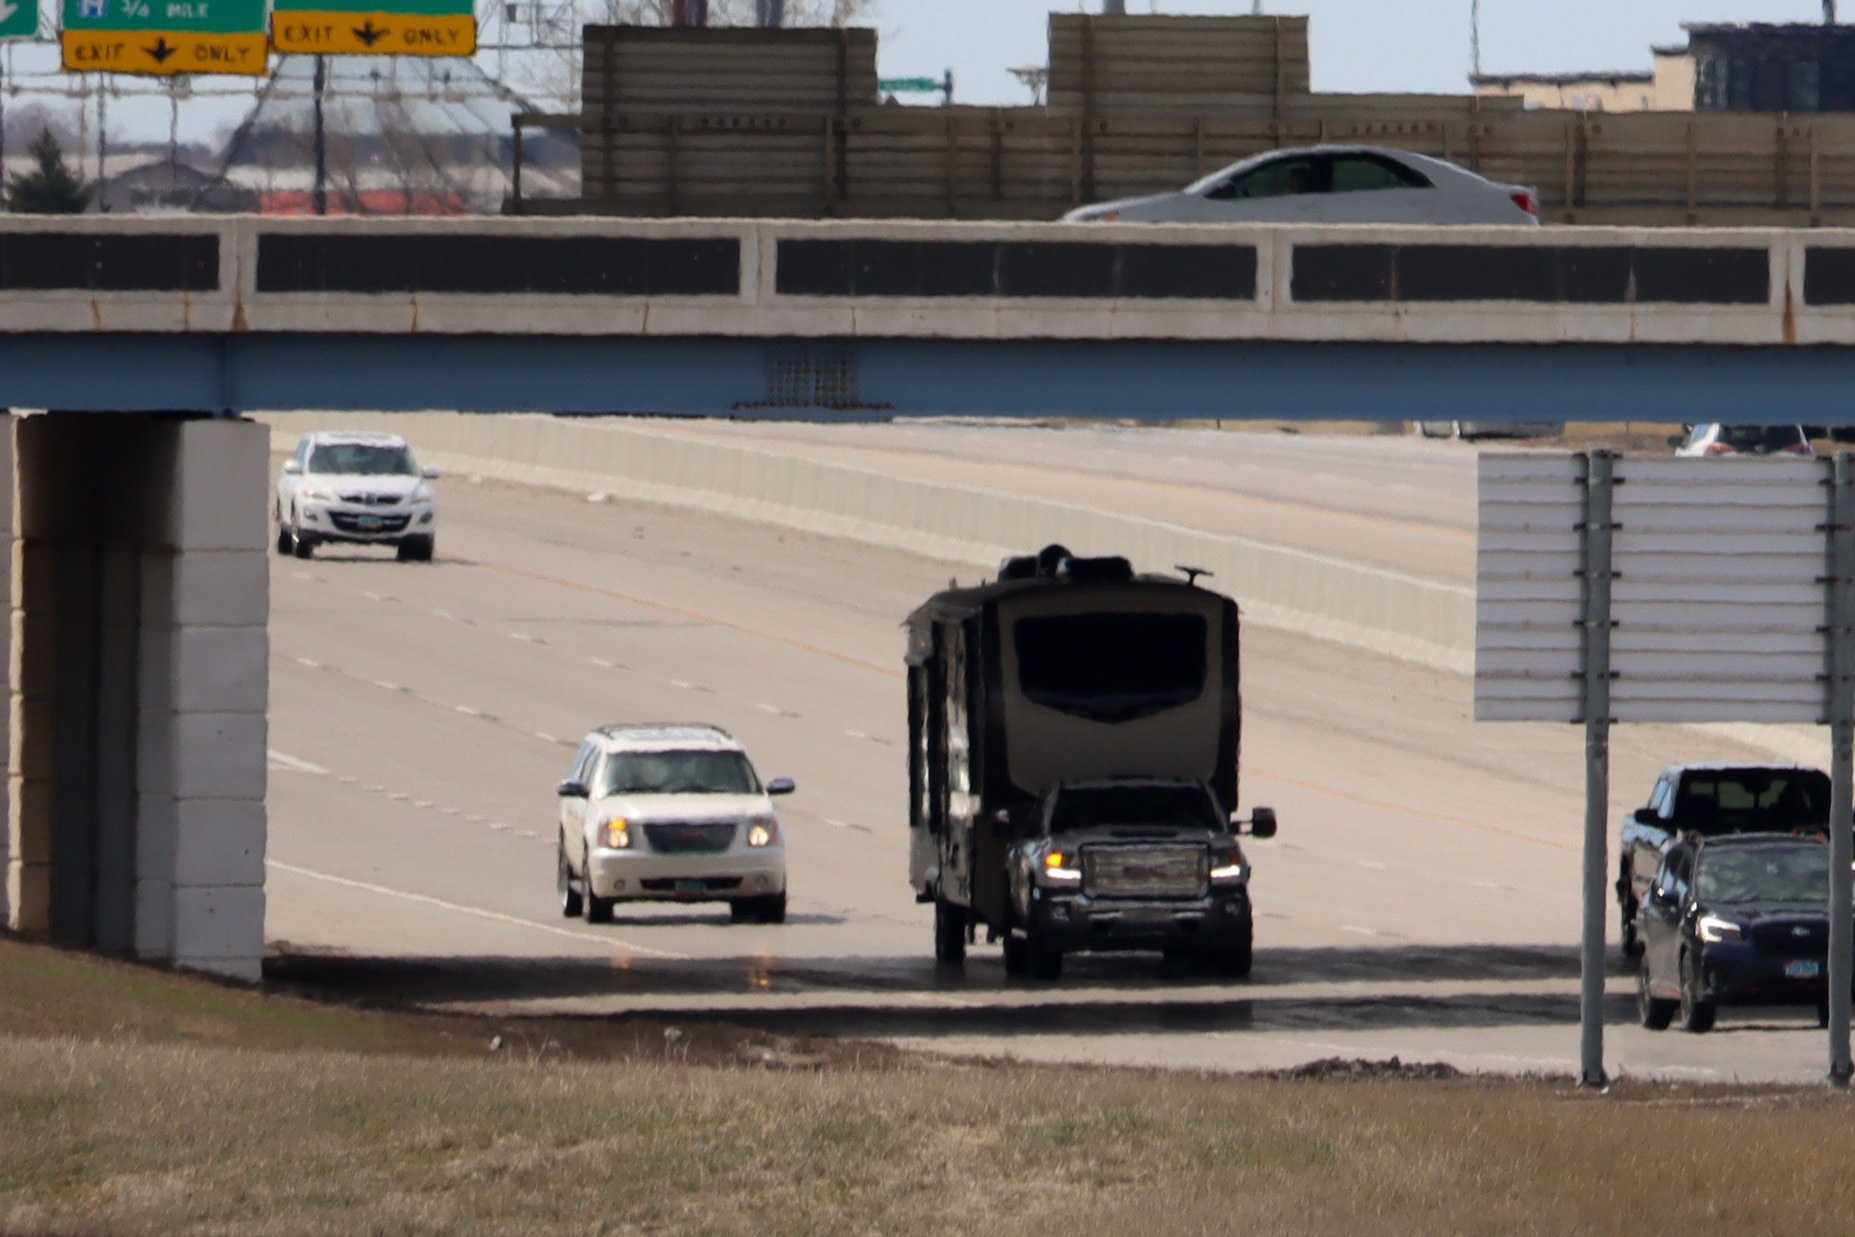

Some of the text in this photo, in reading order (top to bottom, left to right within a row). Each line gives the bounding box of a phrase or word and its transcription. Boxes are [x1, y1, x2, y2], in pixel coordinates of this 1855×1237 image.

[166, 2, 210, 20] MILE
[285, 24, 461, 46] EXIT ONLY
[74, 42, 250, 65] EXIT ONLY
